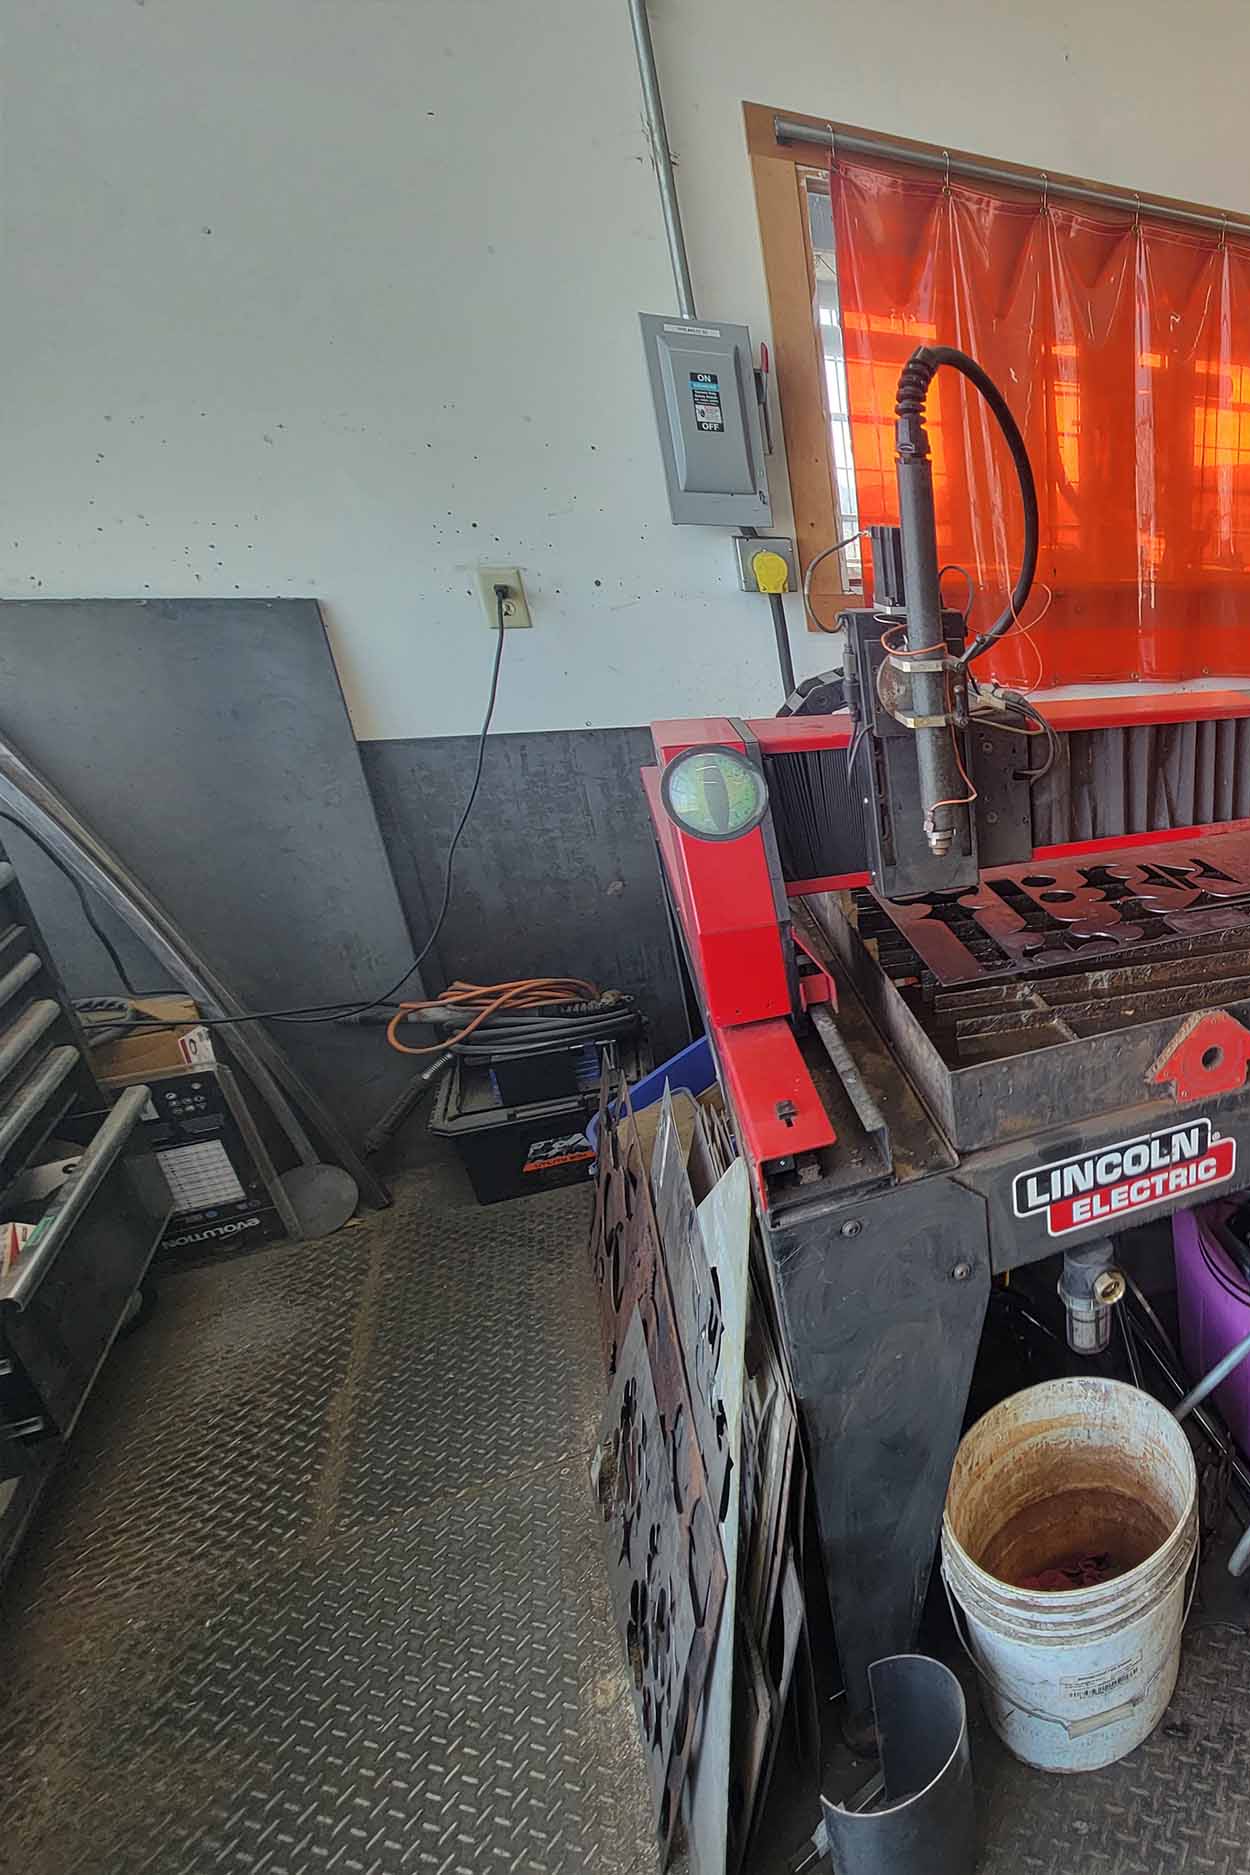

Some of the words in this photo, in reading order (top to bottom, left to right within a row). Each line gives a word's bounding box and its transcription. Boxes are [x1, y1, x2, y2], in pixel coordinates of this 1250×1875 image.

[697, 374, 712, 384] ON
[702, 422, 720, 431] OFF
[1026, 1127, 1200, 1208] LINCOLN
[1072, 1157, 1217, 1223] ELECTRIC
